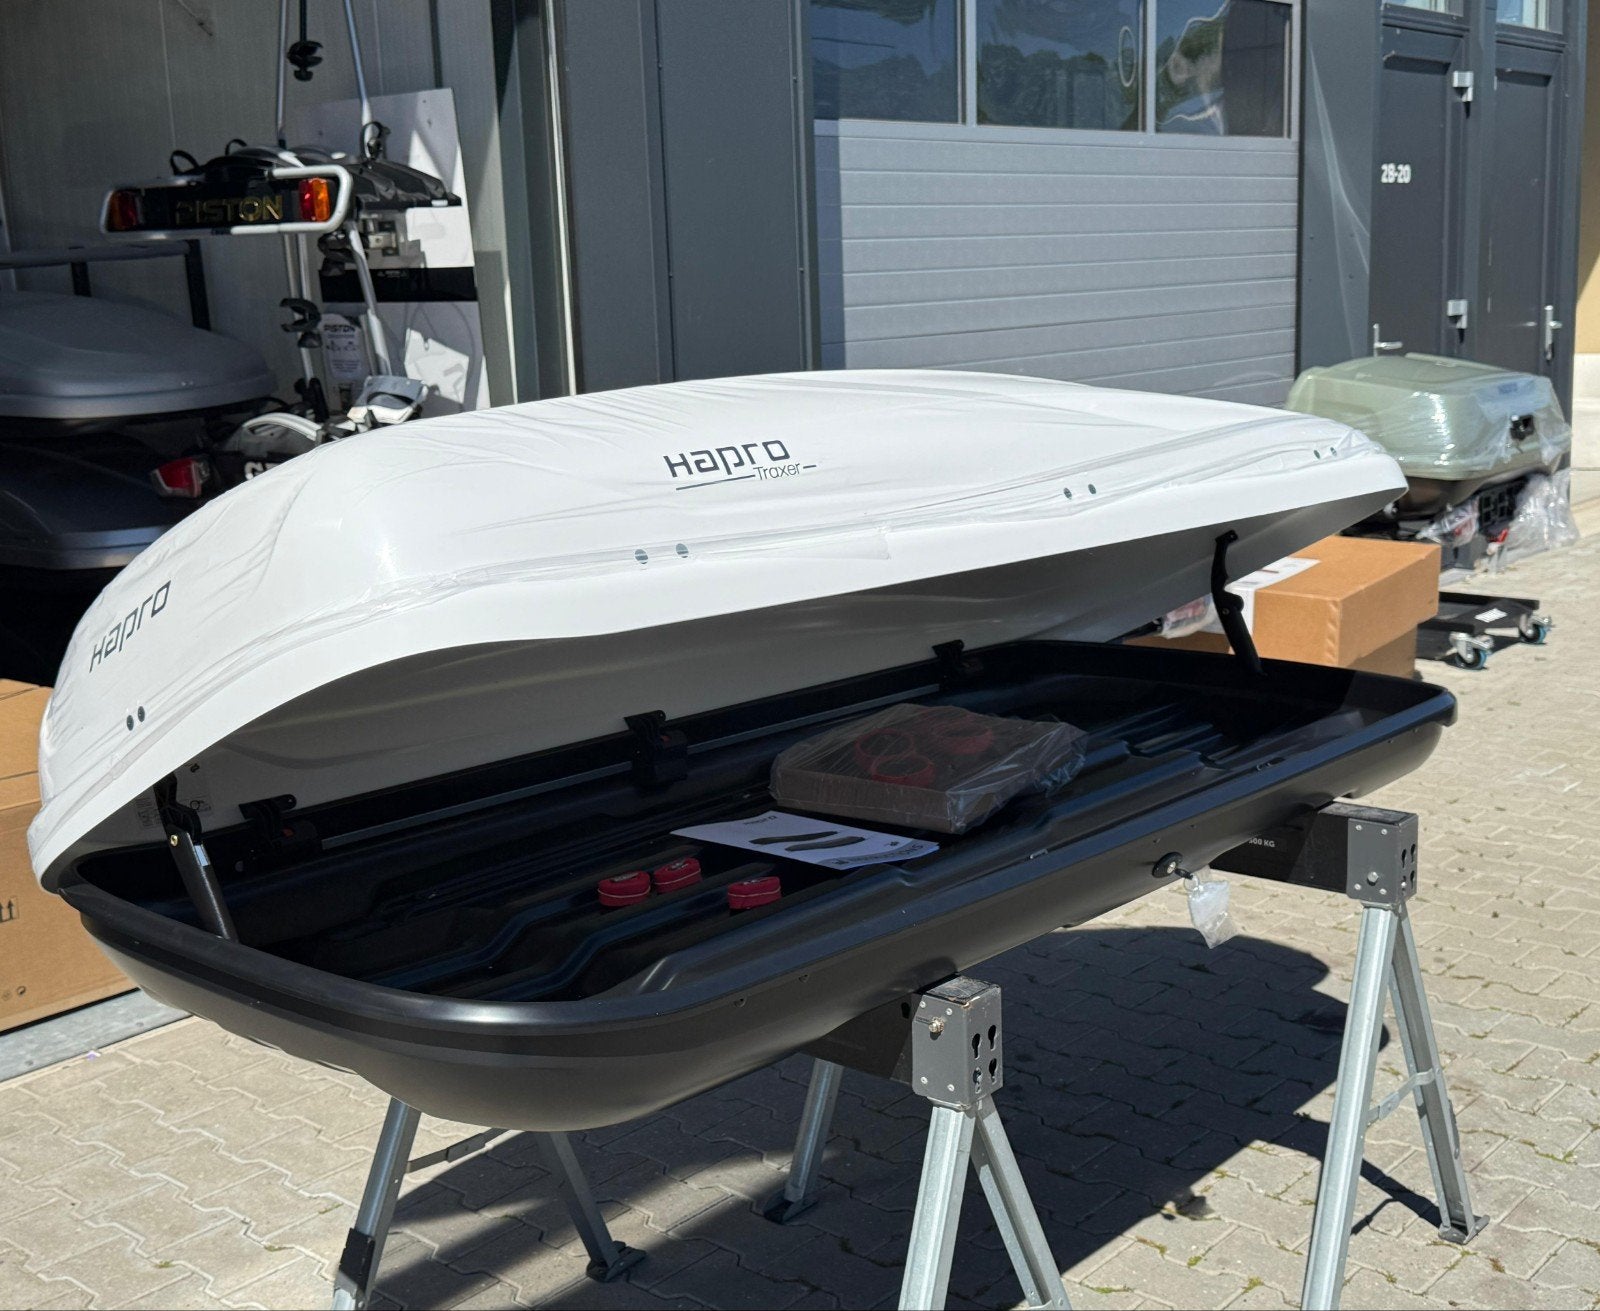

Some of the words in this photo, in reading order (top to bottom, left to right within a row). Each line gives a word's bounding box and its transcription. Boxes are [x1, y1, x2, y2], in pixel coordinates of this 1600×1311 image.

[176, 195, 283, 224] PISTON
[663, 440, 791, 477] Hapro
[753, 462, 801, 481] Traxer
[1264, 839, 1275, 848] KG
